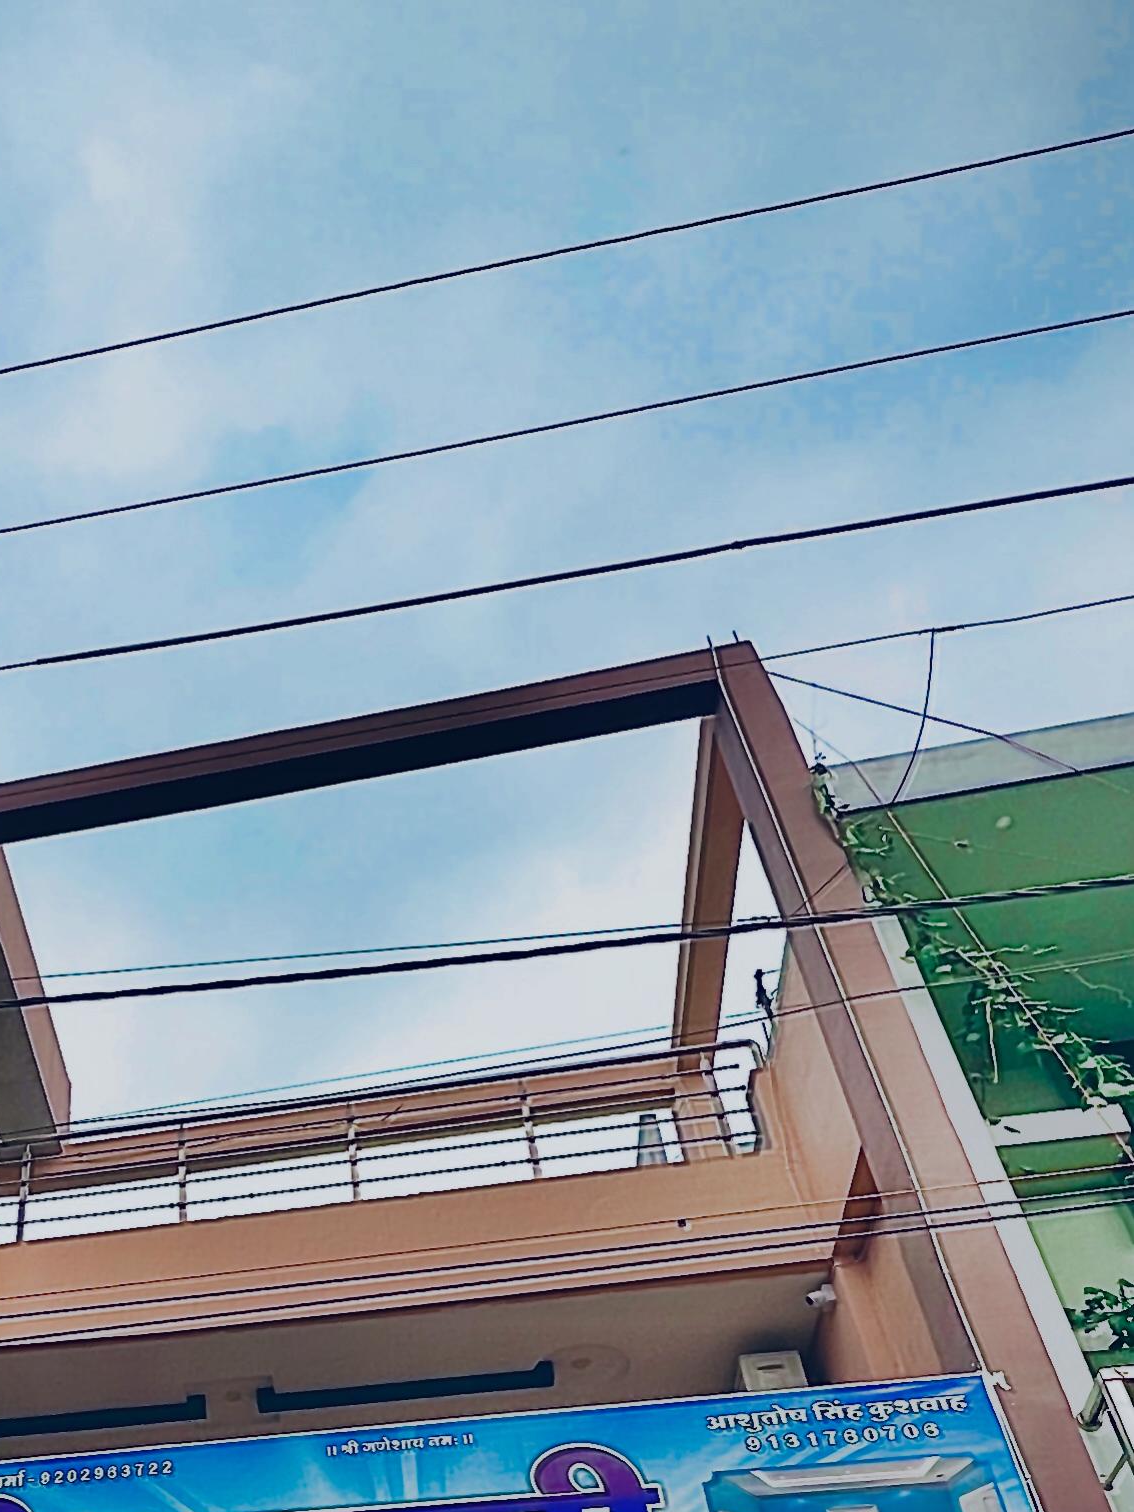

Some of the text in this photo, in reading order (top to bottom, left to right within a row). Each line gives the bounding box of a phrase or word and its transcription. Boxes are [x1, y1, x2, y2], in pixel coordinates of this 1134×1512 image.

[706, 1393, 968, 1433] आशुतोष सिंह कुशवाह
[341, 1439, 359, 1455] श्री
[362, 1436, 424, 1453] गणेशाय
[745, 1422, 941, 1452] 9131760706
